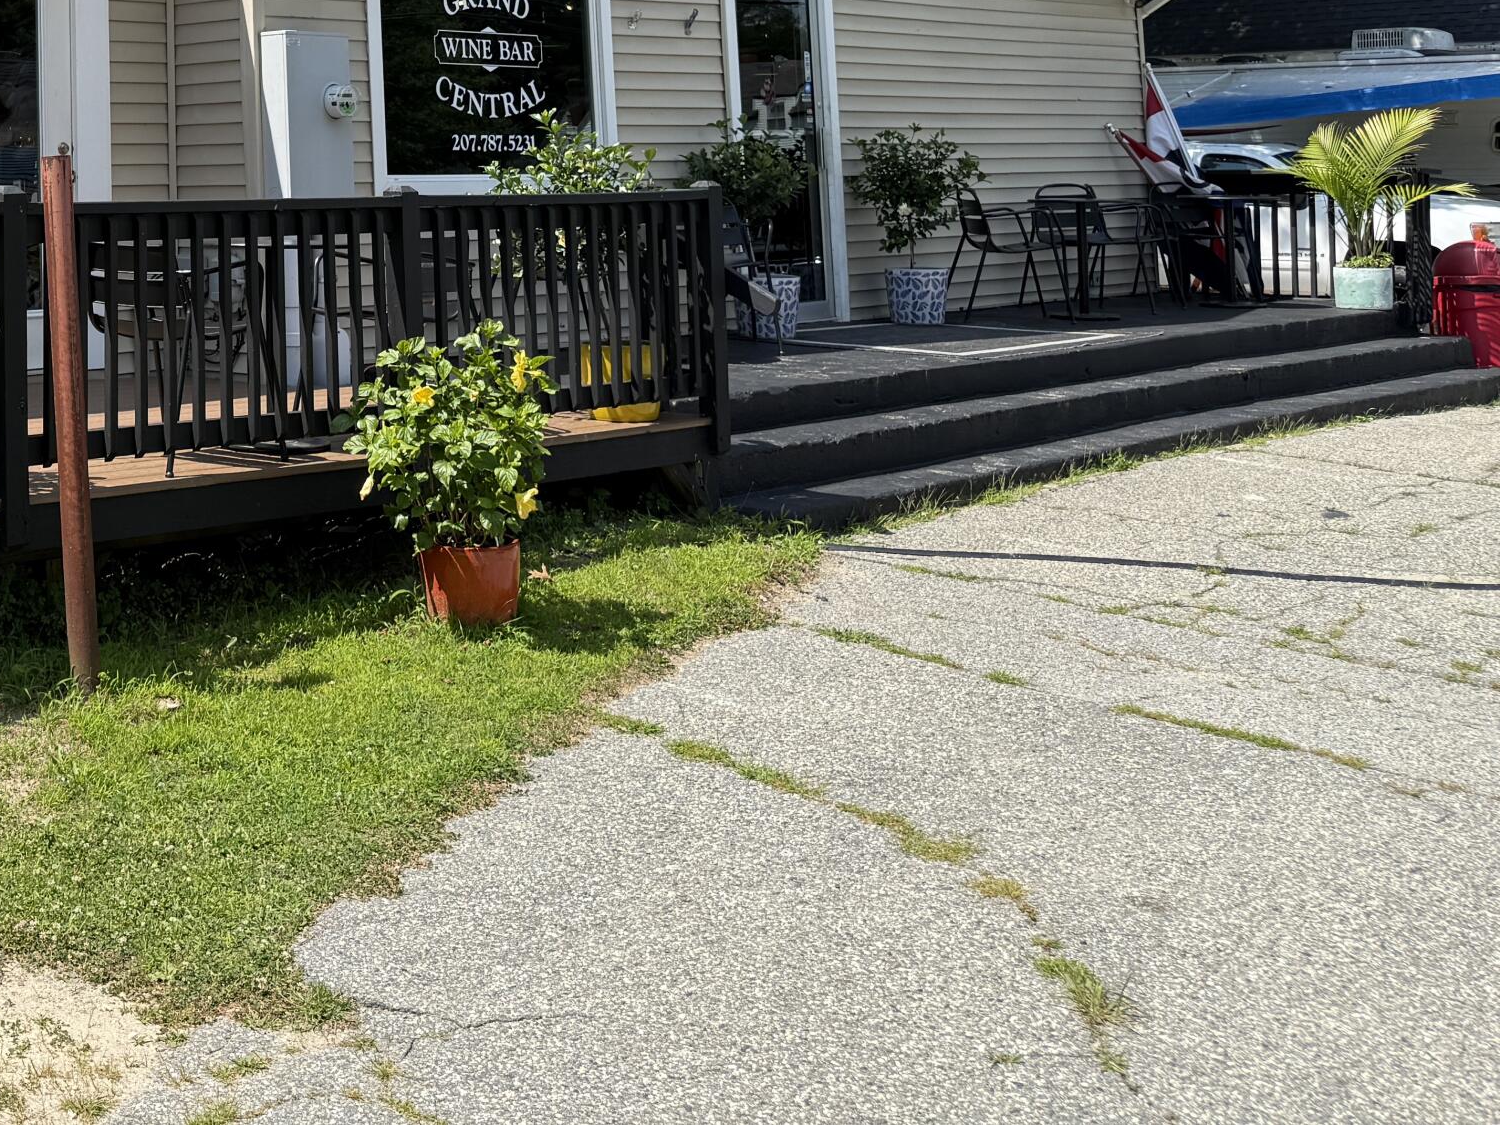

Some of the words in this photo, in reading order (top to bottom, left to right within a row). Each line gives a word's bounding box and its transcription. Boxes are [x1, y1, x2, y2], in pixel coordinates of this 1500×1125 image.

[441, 36, 493, 61] WINE
[499, 39, 536, 62] BAR
[435, 75, 546, 119] CENTRAL
[451, 133, 536, 152] 207.787.5231
